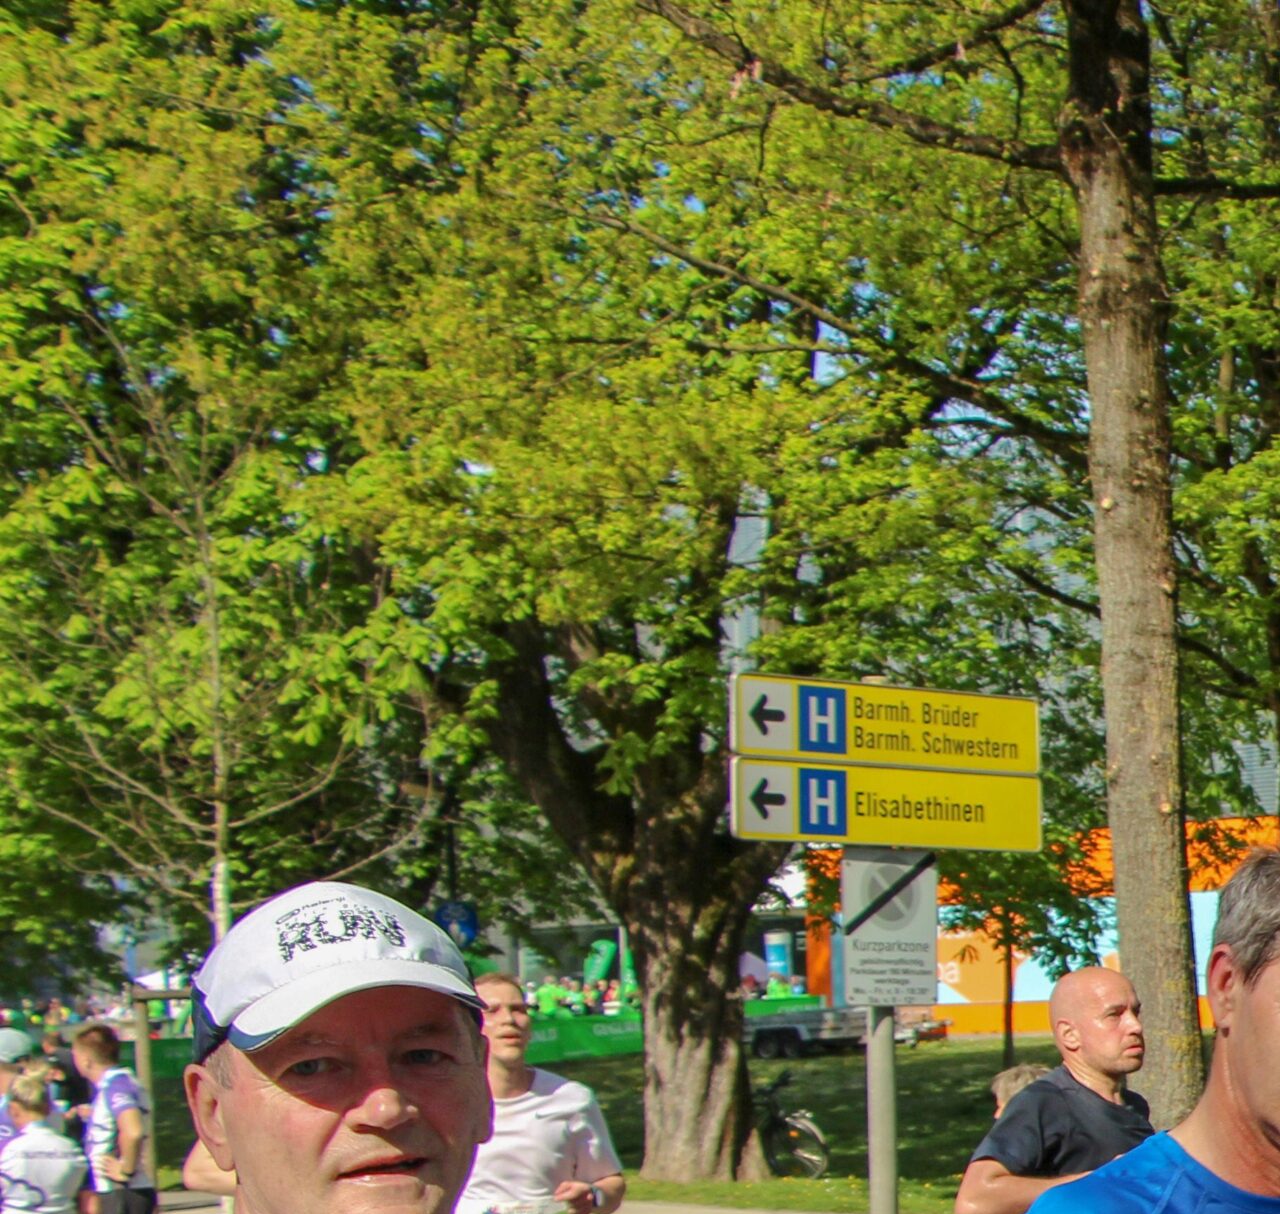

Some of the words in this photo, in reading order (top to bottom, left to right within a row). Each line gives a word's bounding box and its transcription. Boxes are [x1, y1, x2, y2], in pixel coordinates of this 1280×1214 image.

[854, 696, 916, 724] Barmh.
[922, 703, 978, 729] Brüder
[854, 726, 916, 753] Barmh.
[922, 731, 1019, 760] Schwestern
[854, 791, 986, 824] Elisabethinen
[852, 938, 929, 953] Kurzparkzone
